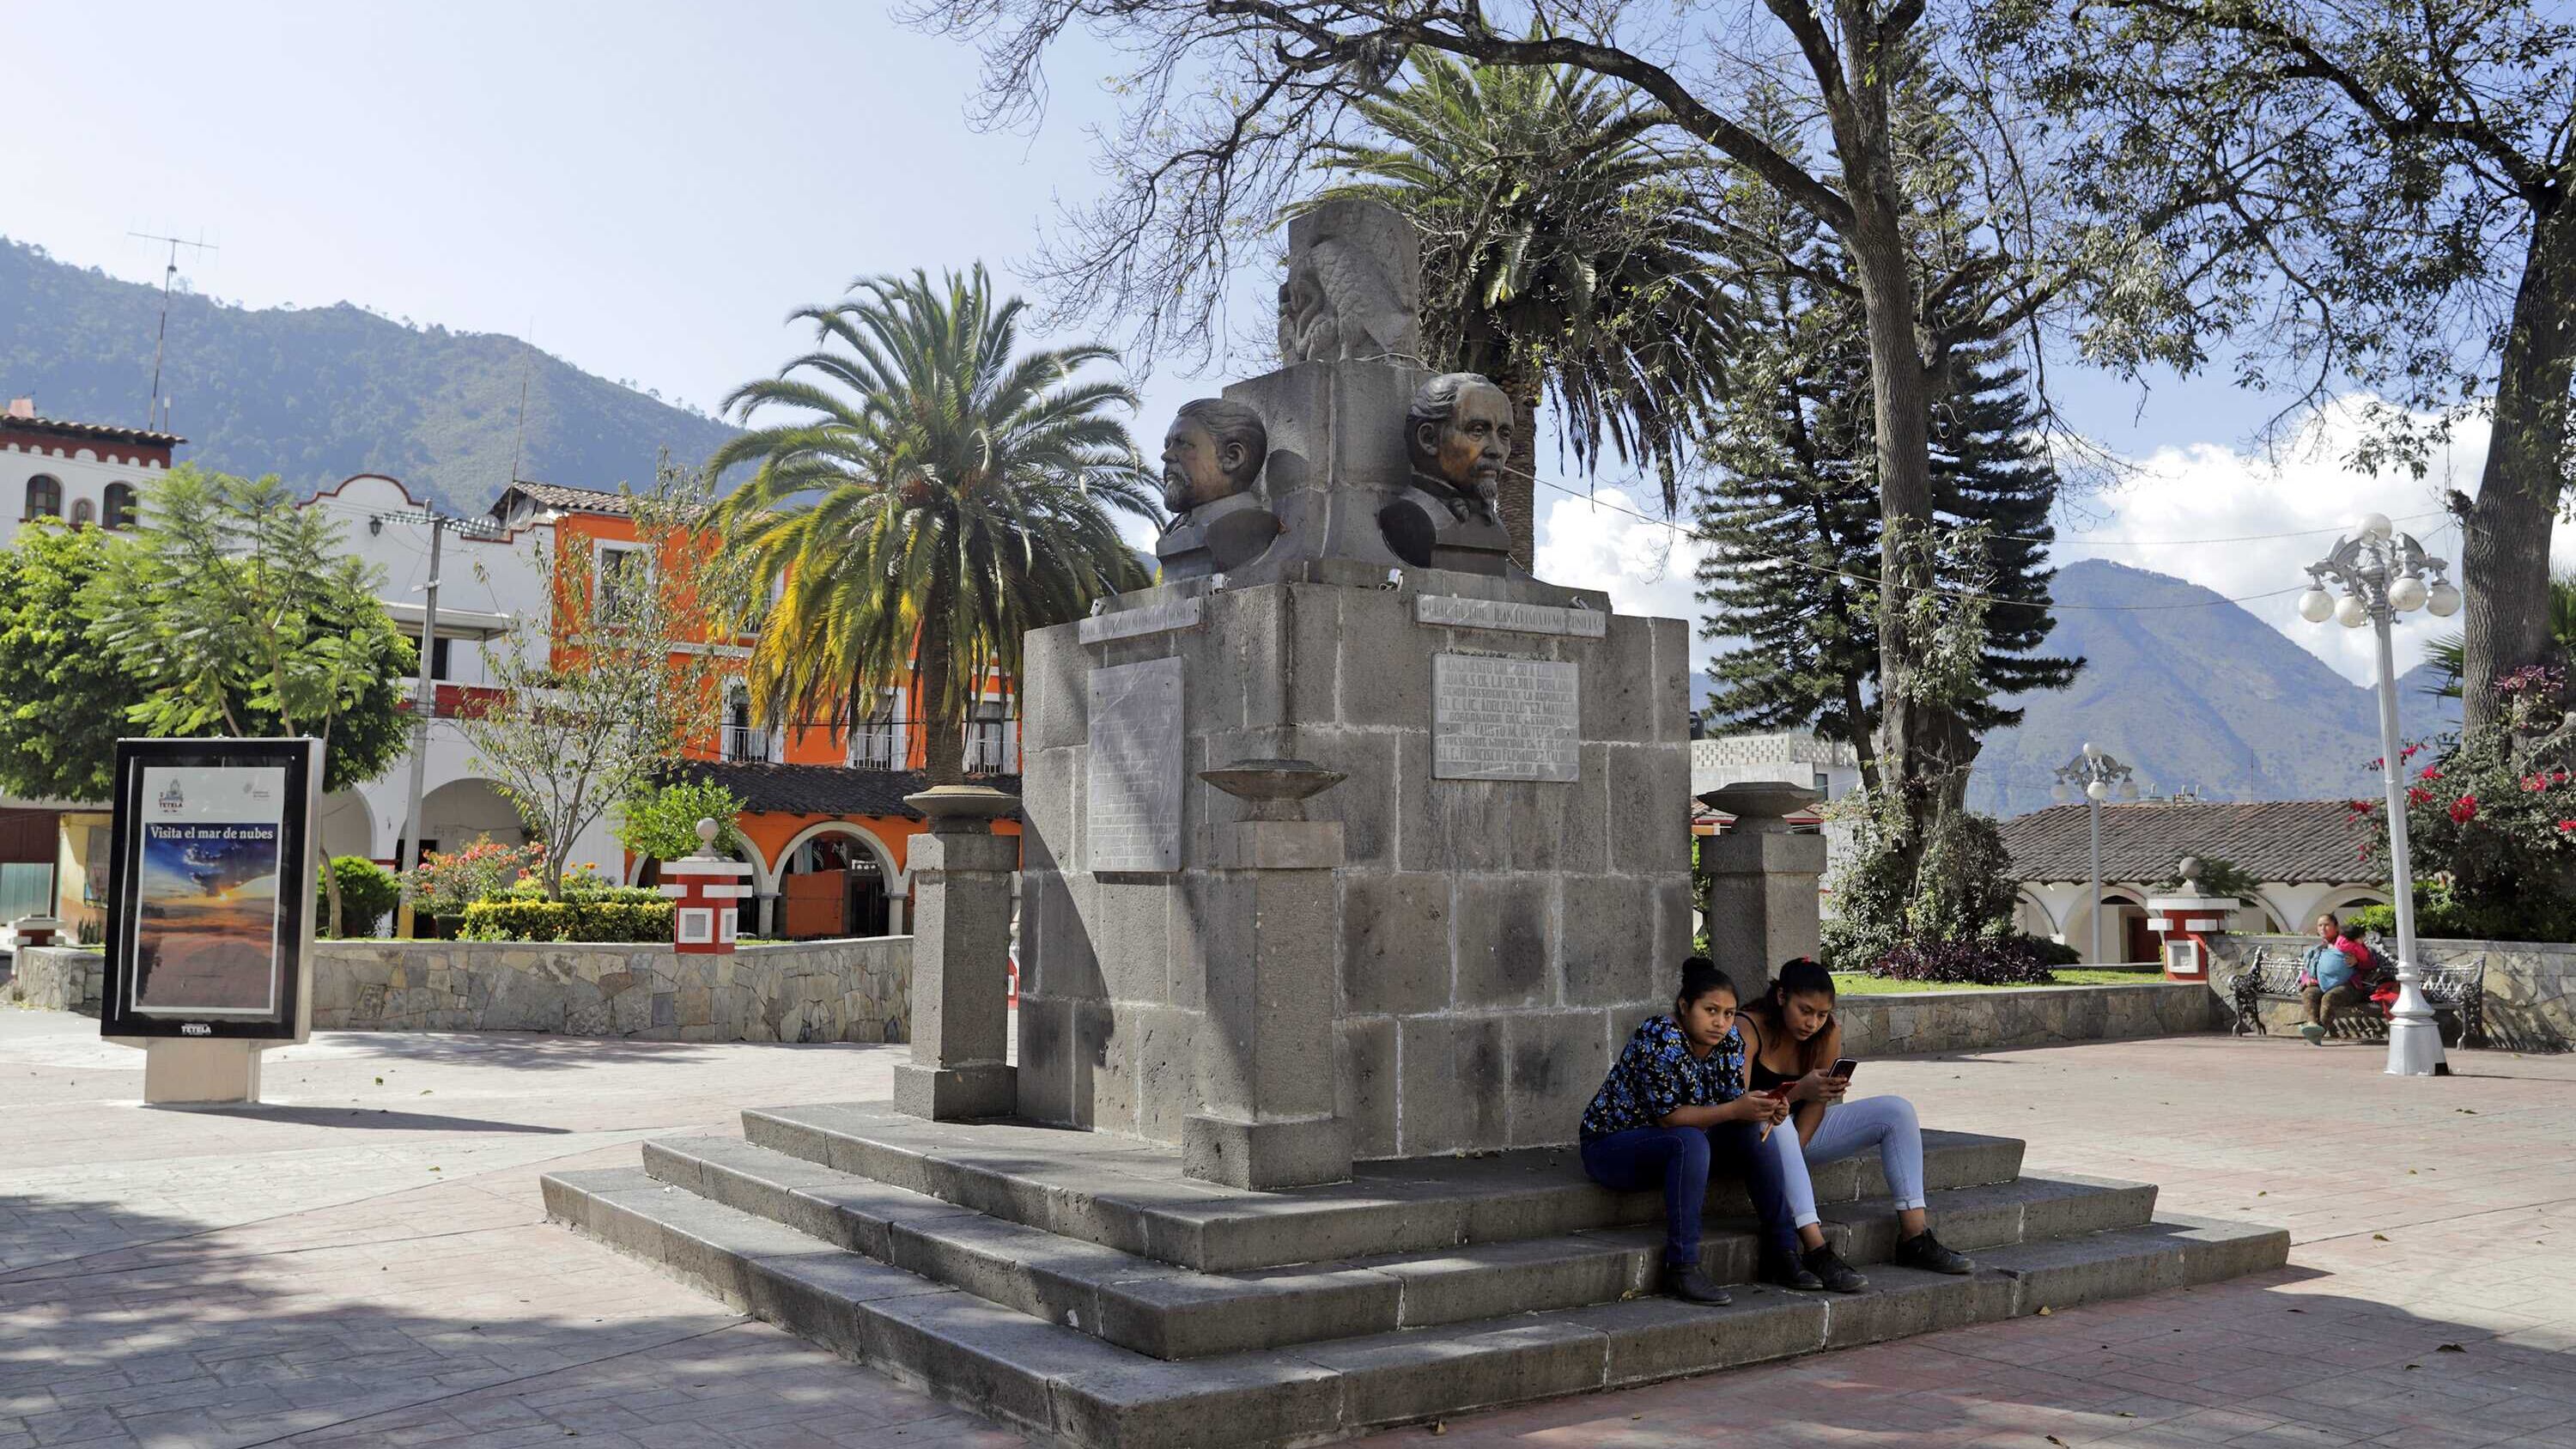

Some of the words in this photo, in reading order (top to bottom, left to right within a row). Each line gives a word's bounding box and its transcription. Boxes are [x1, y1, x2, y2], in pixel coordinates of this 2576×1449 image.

[1491, 675, 1502, 688] LA
[1480, 699, 1512, 713] ADOLFO
[1474, 723, 1505, 736] FAUSTO
[150, 825, 182, 839] Visita
[184, 826, 195, 839] el
[197, 829, 221, 839] mar
[223, 827, 237, 839] de
[239, 827, 273, 839] nubes
